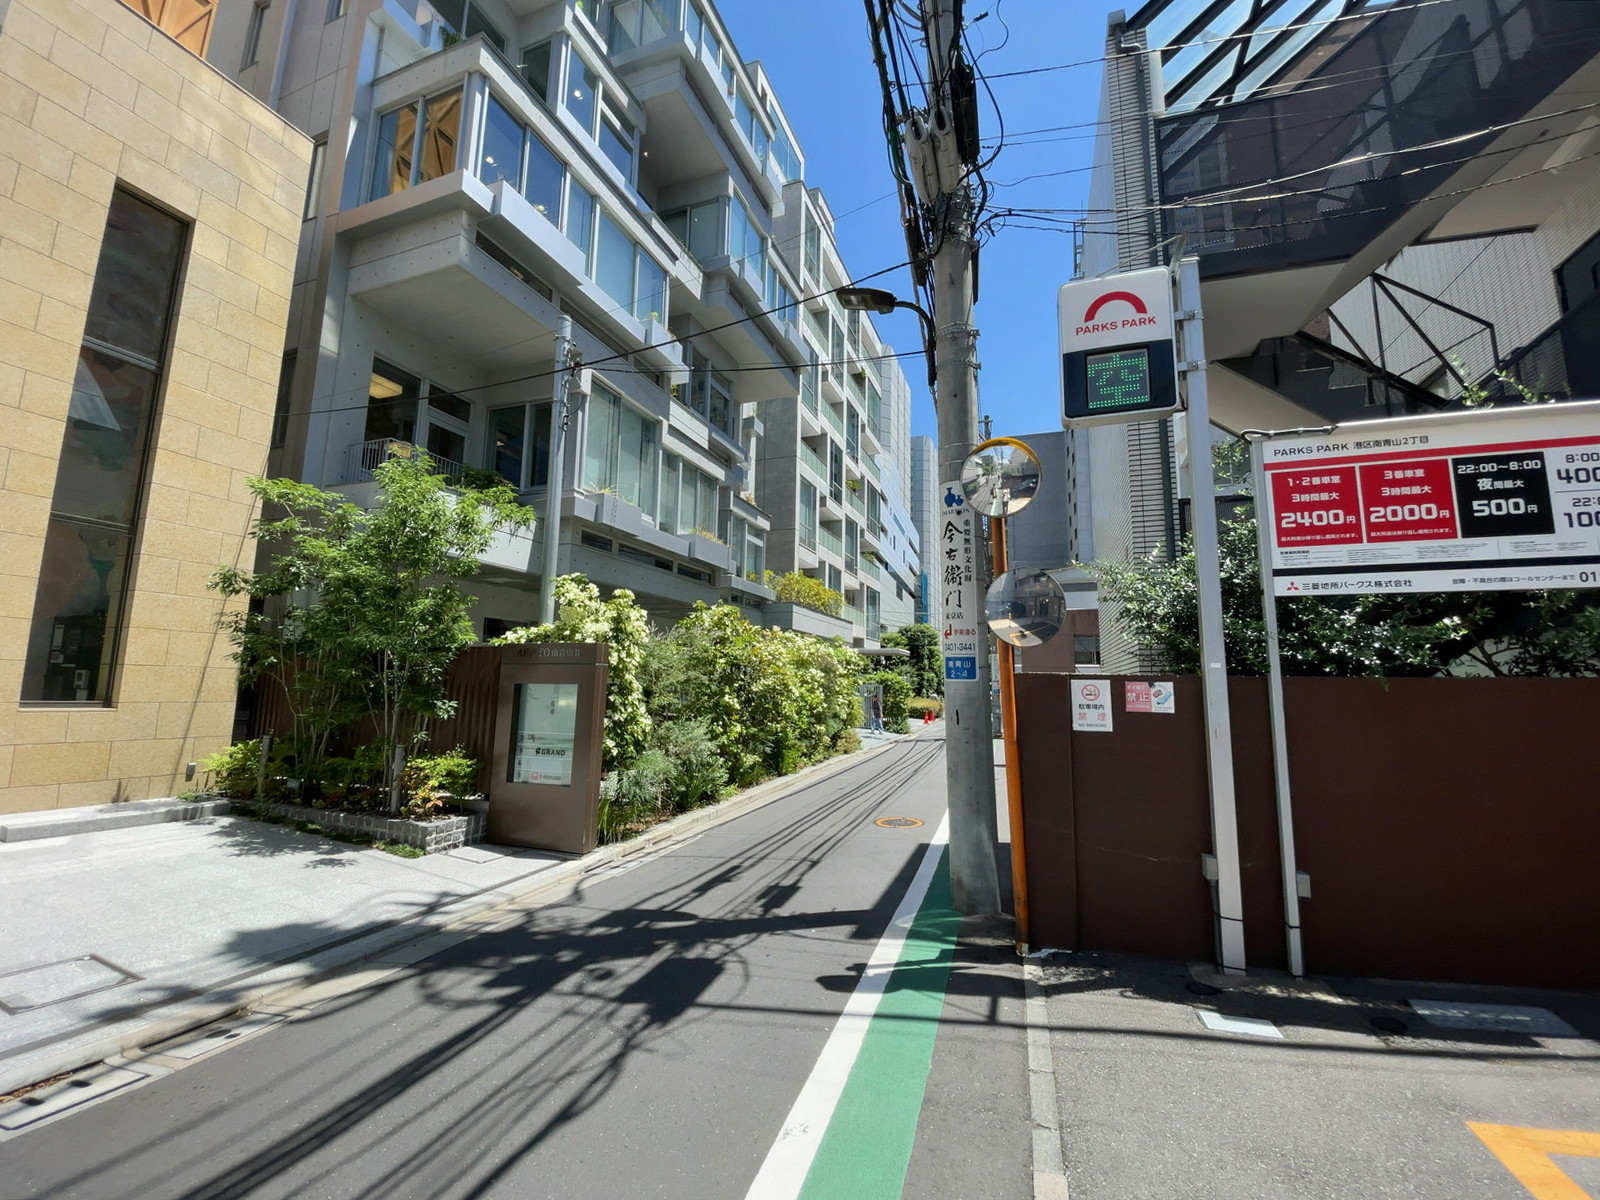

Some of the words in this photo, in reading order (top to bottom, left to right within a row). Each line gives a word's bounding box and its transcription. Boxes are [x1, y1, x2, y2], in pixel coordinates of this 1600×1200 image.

[1076, 322, 1118, 336] PARKS
[1122, 316, 1157, 329] PARK
[1087, 354, 1149, 408] 空
[1274, 446, 1313, 457] PARKS
[1317, 442, 1350, 453] PARK
[1353, 435, 1429, 450] 港区南青山2丁目
[1383, 468, 1425, 480] 3番車室
[1381, 485, 1432, 496] 3時間最大
[1477, 478, 1525, 491] 夜間最大
[1291, 492, 1340, 503] 3時間最大
[1369, 503, 1450, 523] 2000円
[1472, 498, 1538, 517] 500円
[1280, 509, 1356, 528] 2400円
[963, 519, 972, 582] 重要無形文化財
[1302, 579, 1413, 590] 三菱地所パークス株式会社
[948, 660, 971, 668] 南青山
[541, 748, 566, 757] GRAND
